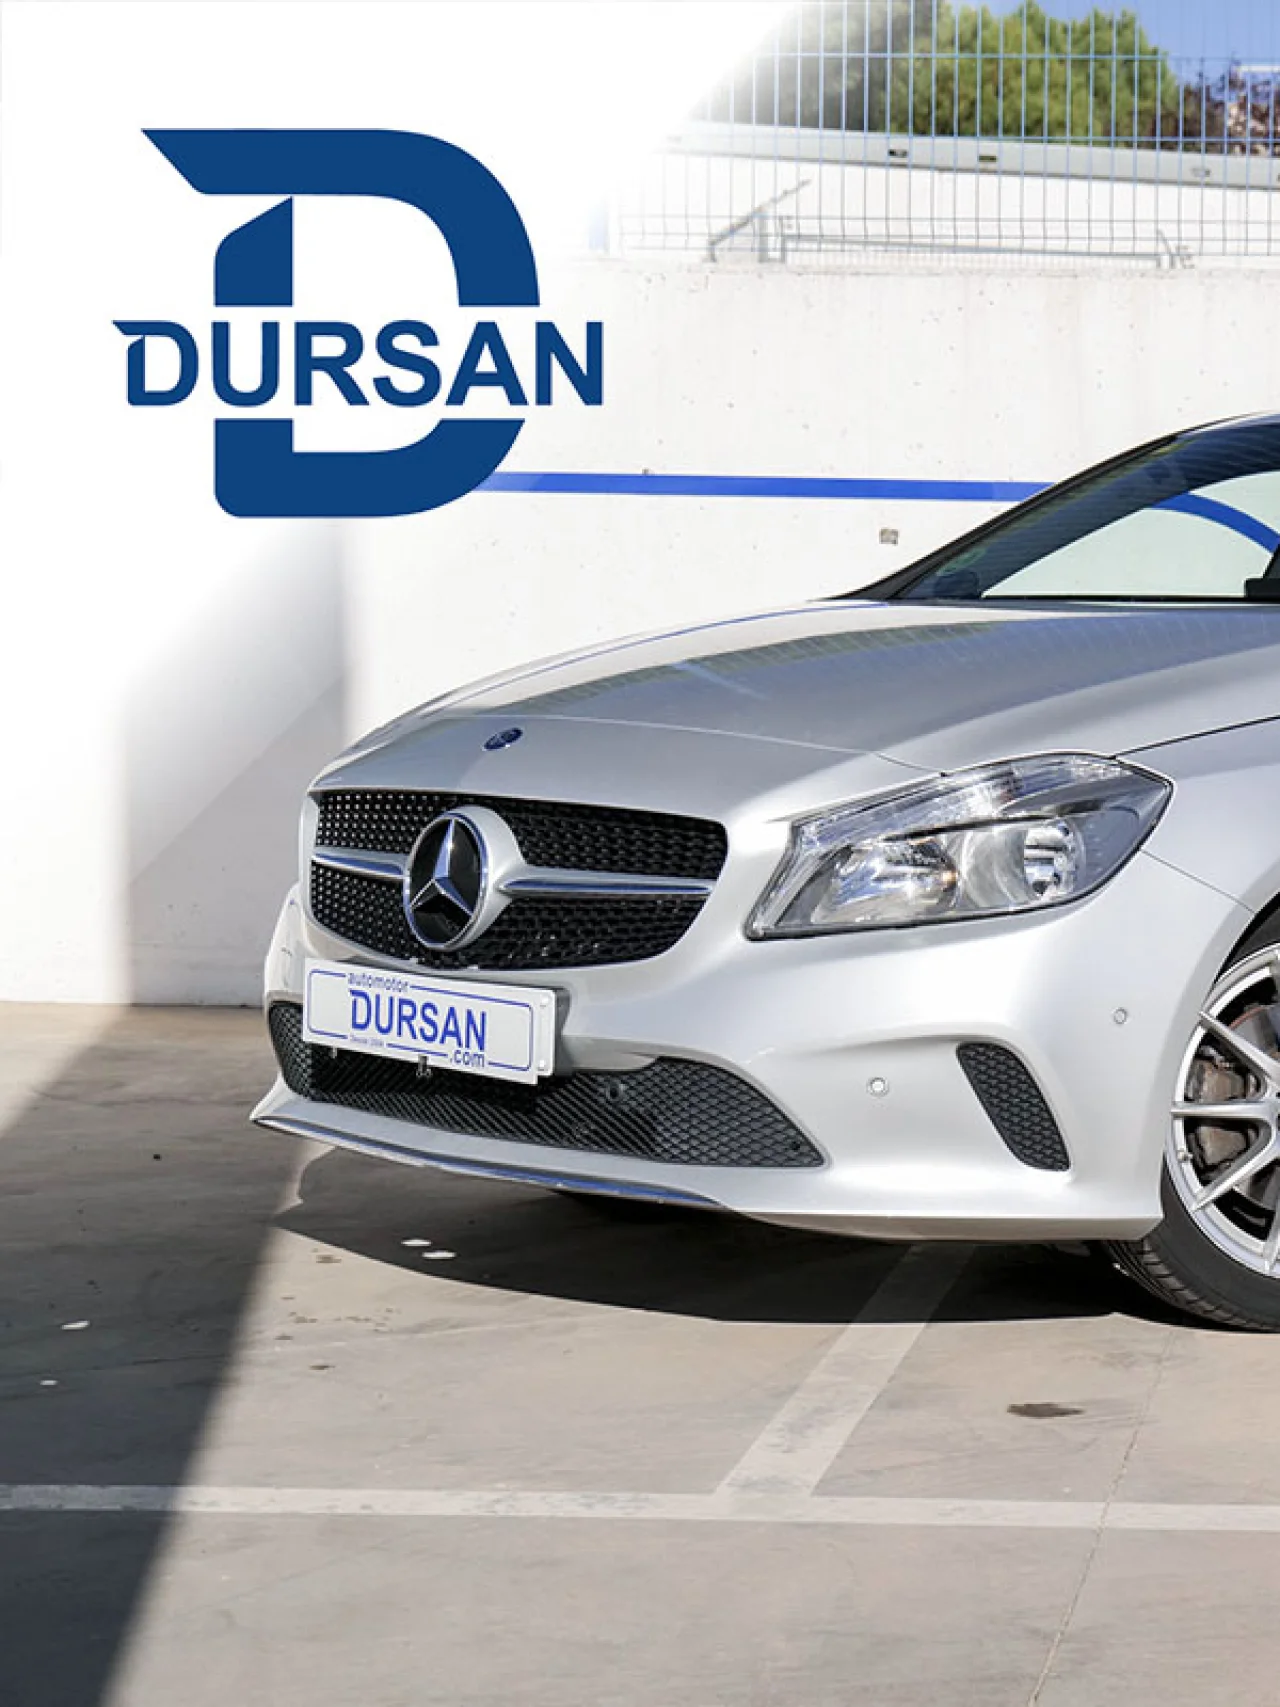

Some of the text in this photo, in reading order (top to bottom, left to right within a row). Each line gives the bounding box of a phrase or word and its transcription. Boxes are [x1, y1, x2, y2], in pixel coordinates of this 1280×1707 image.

[347, 972, 409, 992] automotor
[349, 989, 486, 1051] DURSAN
[449, 1049, 486, 1068] .com
